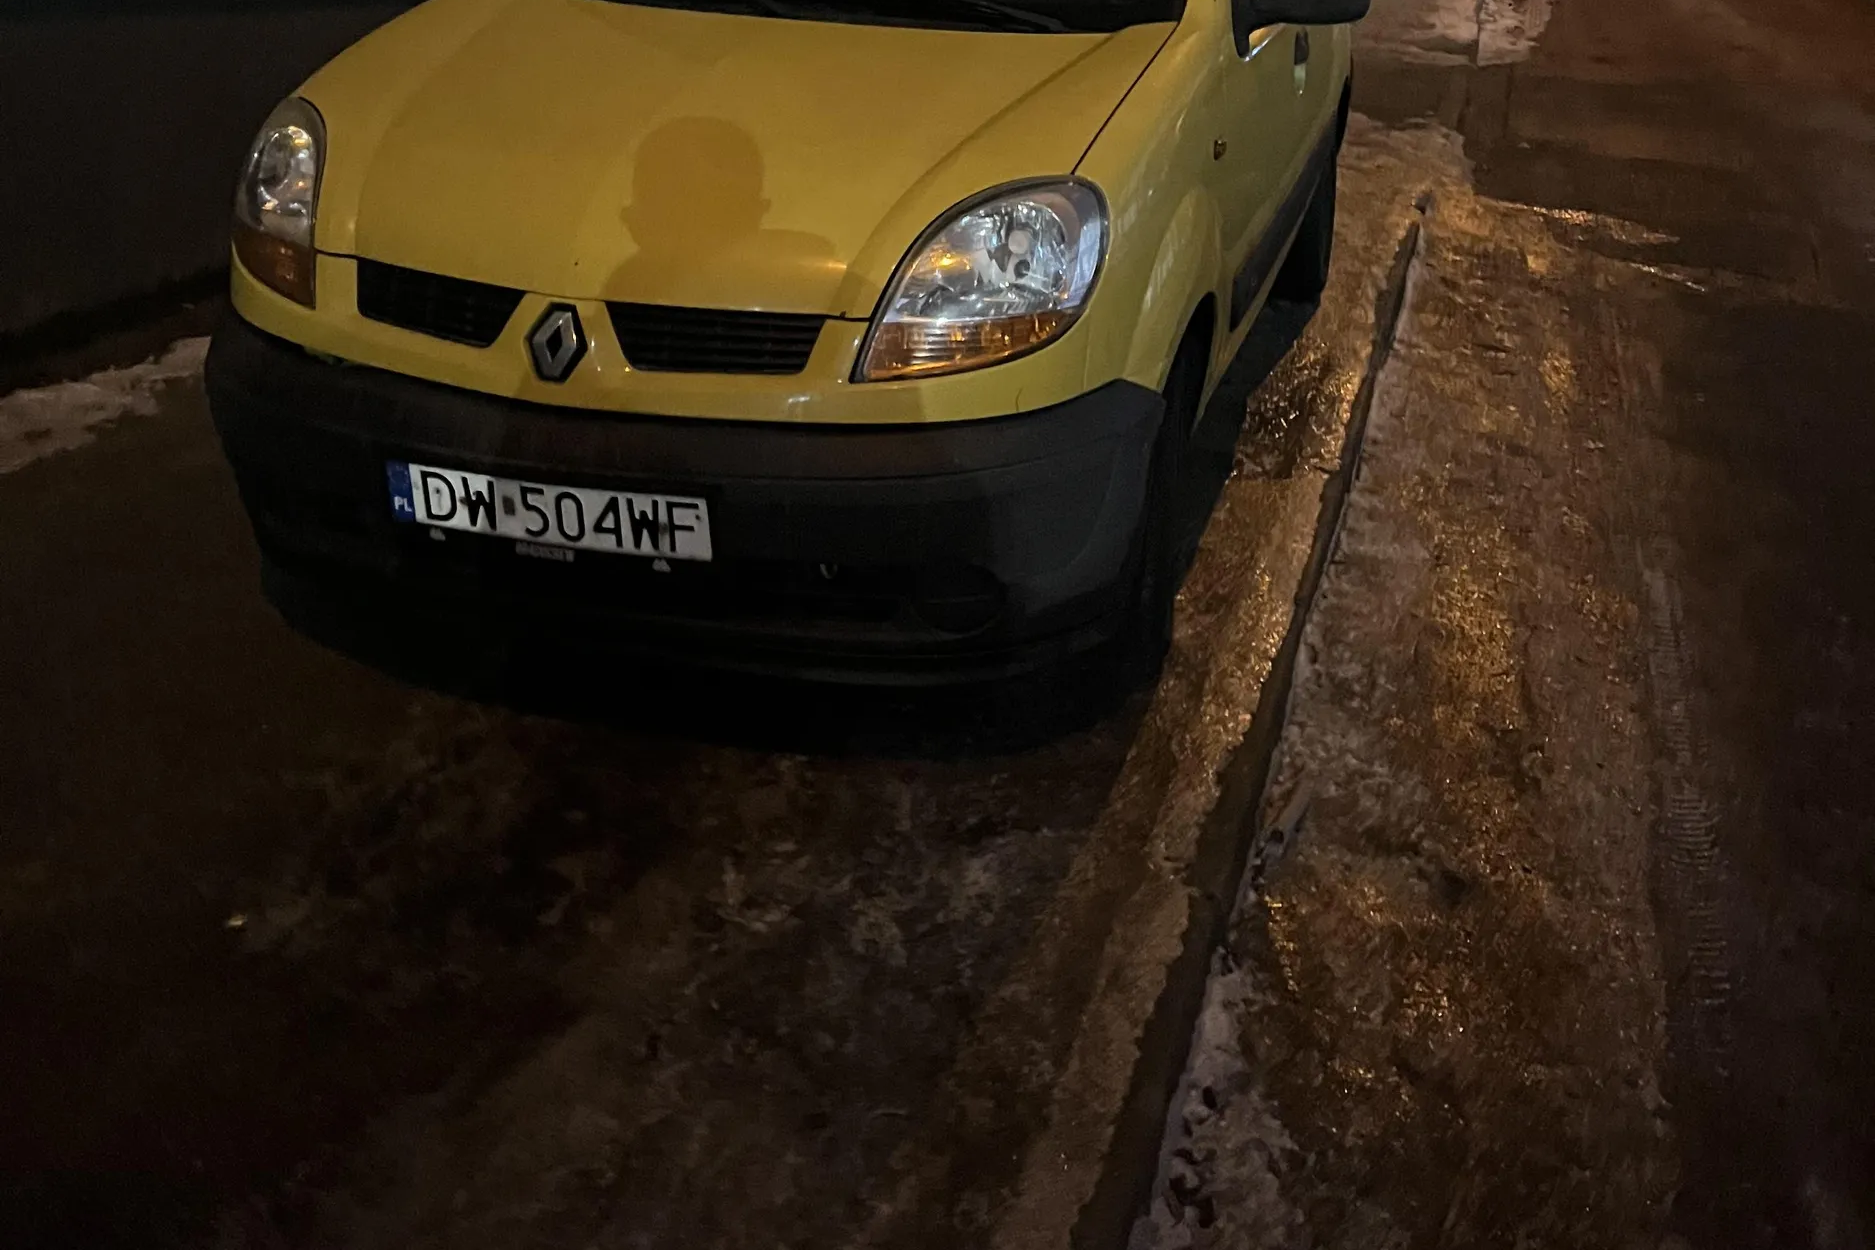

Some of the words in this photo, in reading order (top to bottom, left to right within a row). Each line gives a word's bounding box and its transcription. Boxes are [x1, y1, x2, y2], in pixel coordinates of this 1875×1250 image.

[393, 495, 413, 513] PL
[420, 470, 497, 531] DW
[519, 484, 700, 553] 504WF
